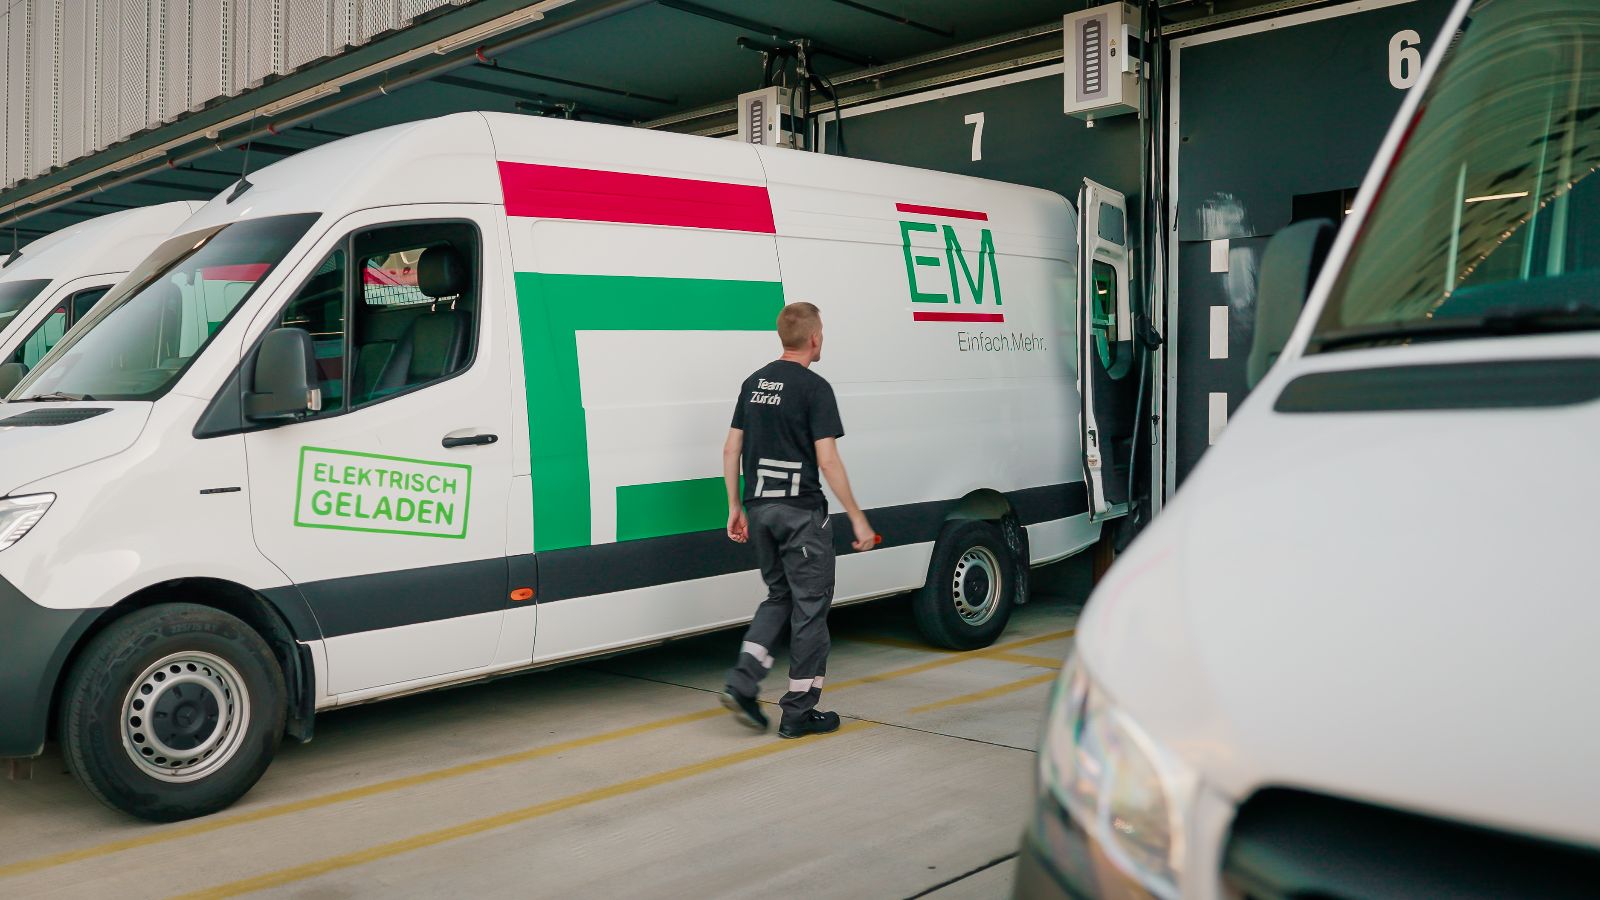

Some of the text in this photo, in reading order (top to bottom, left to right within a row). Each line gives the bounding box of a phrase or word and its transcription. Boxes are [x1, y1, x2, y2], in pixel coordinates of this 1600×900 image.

[1388, 29, 1421, 90] 6
[964, 111, 985, 162] 7
[898, 220, 1002, 305] EM
[750, 391, 781, 406] Zürich
[757, 378, 784, 391] Team
[313, 462, 457, 495] ELEKTRISCH
[311, 489, 454, 526] GELADEN
